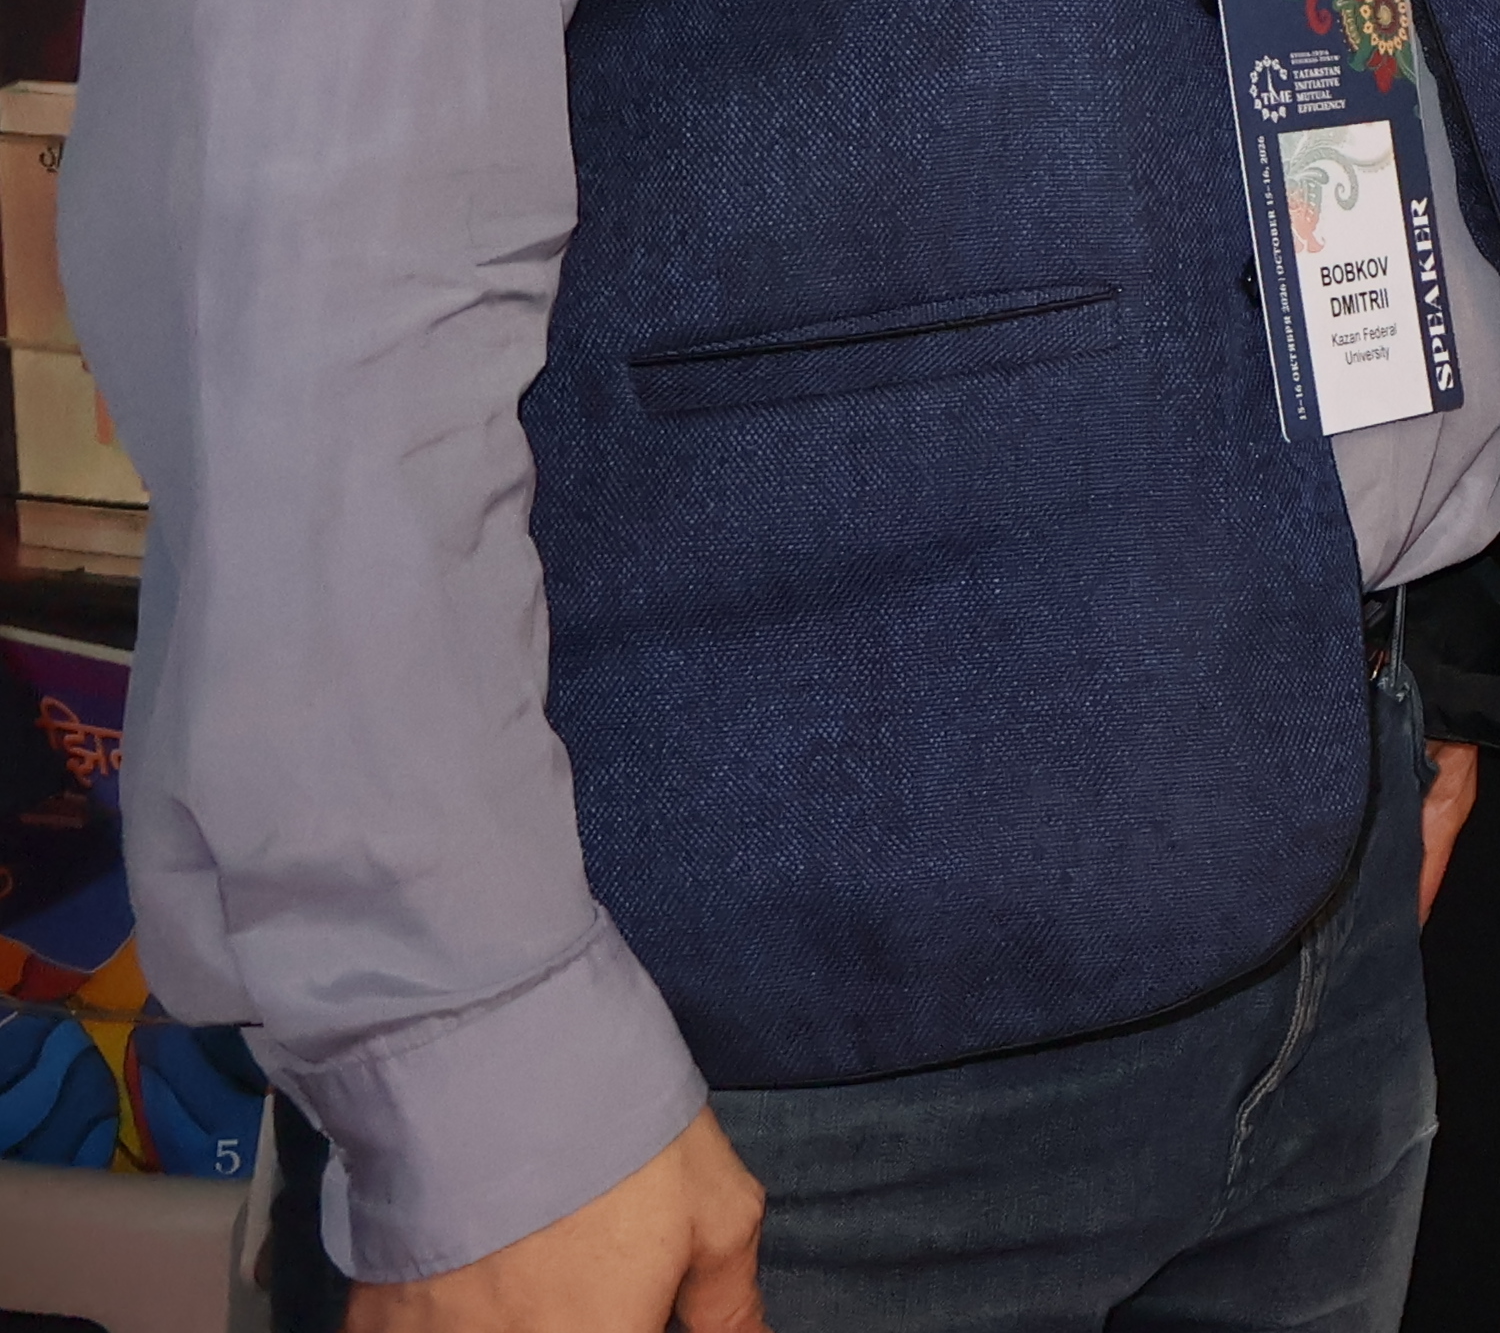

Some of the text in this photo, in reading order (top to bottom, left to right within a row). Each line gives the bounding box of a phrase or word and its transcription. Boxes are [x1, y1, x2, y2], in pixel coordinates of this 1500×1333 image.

[1320, 256, 1389, 287] BOBKOV
[1330, 289, 1390, 318] DMITRII
[1410, 197, 1454, 392] SPEAKER
[1331, 323, 1397, 348] Kazan Federal
[1345, 345, 1390, 366] University
[215, 1139, 240, 1174] 5
